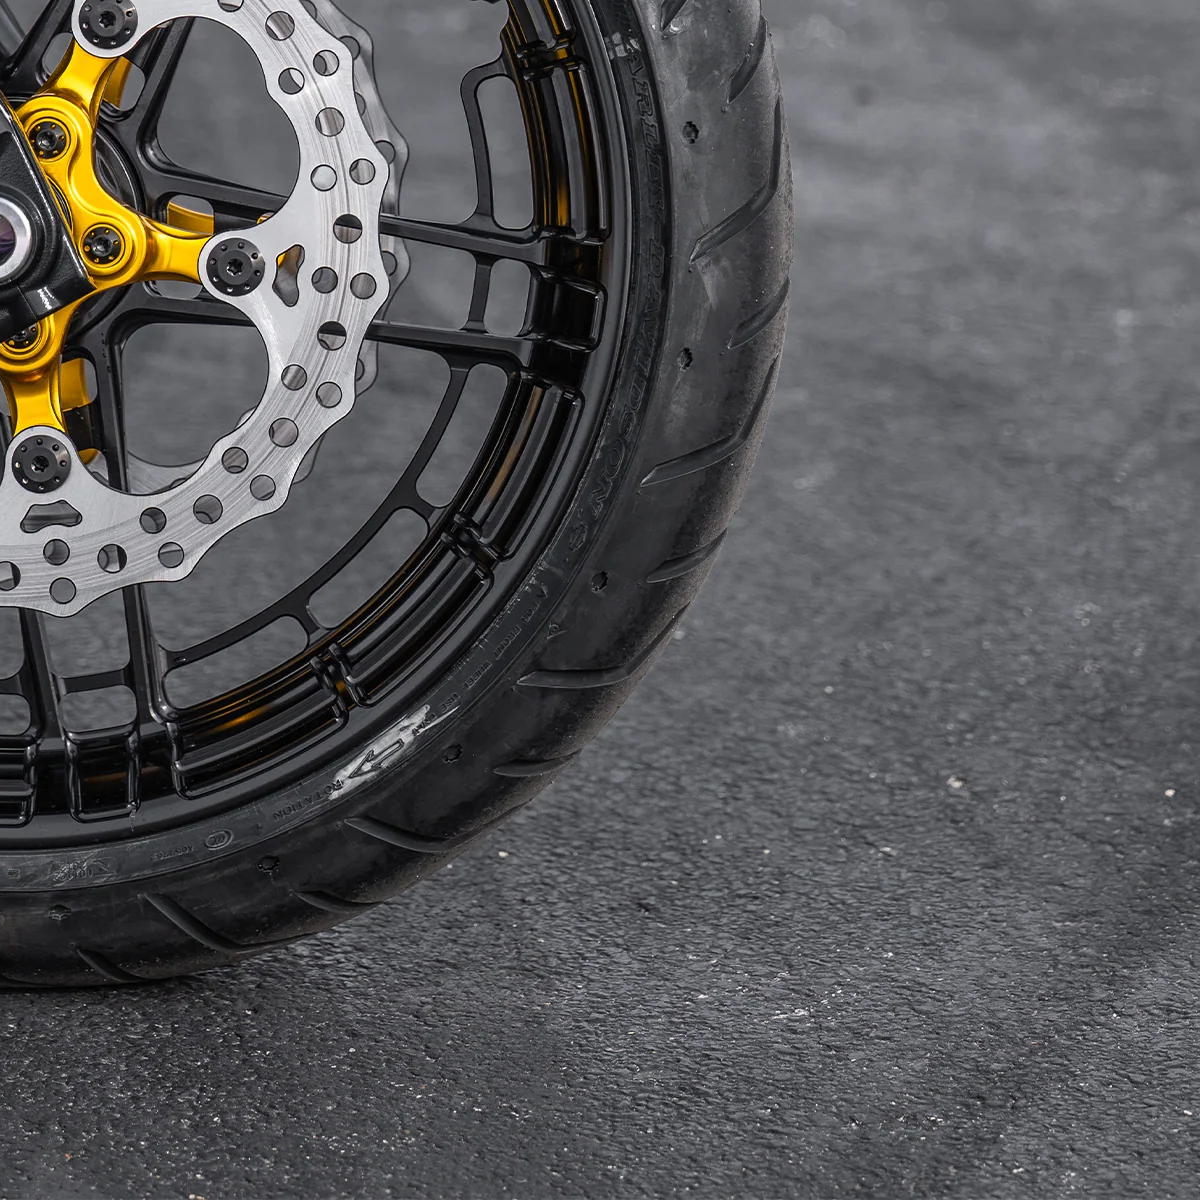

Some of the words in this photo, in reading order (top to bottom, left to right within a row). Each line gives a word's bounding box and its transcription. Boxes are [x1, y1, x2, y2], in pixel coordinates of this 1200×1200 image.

[489, 623, 523, 661] FRONT
[460, 658, 493, 692] WHEEL
[437, 691, 461, 713] USE
[271, 777, 345, 822] ROTATION
